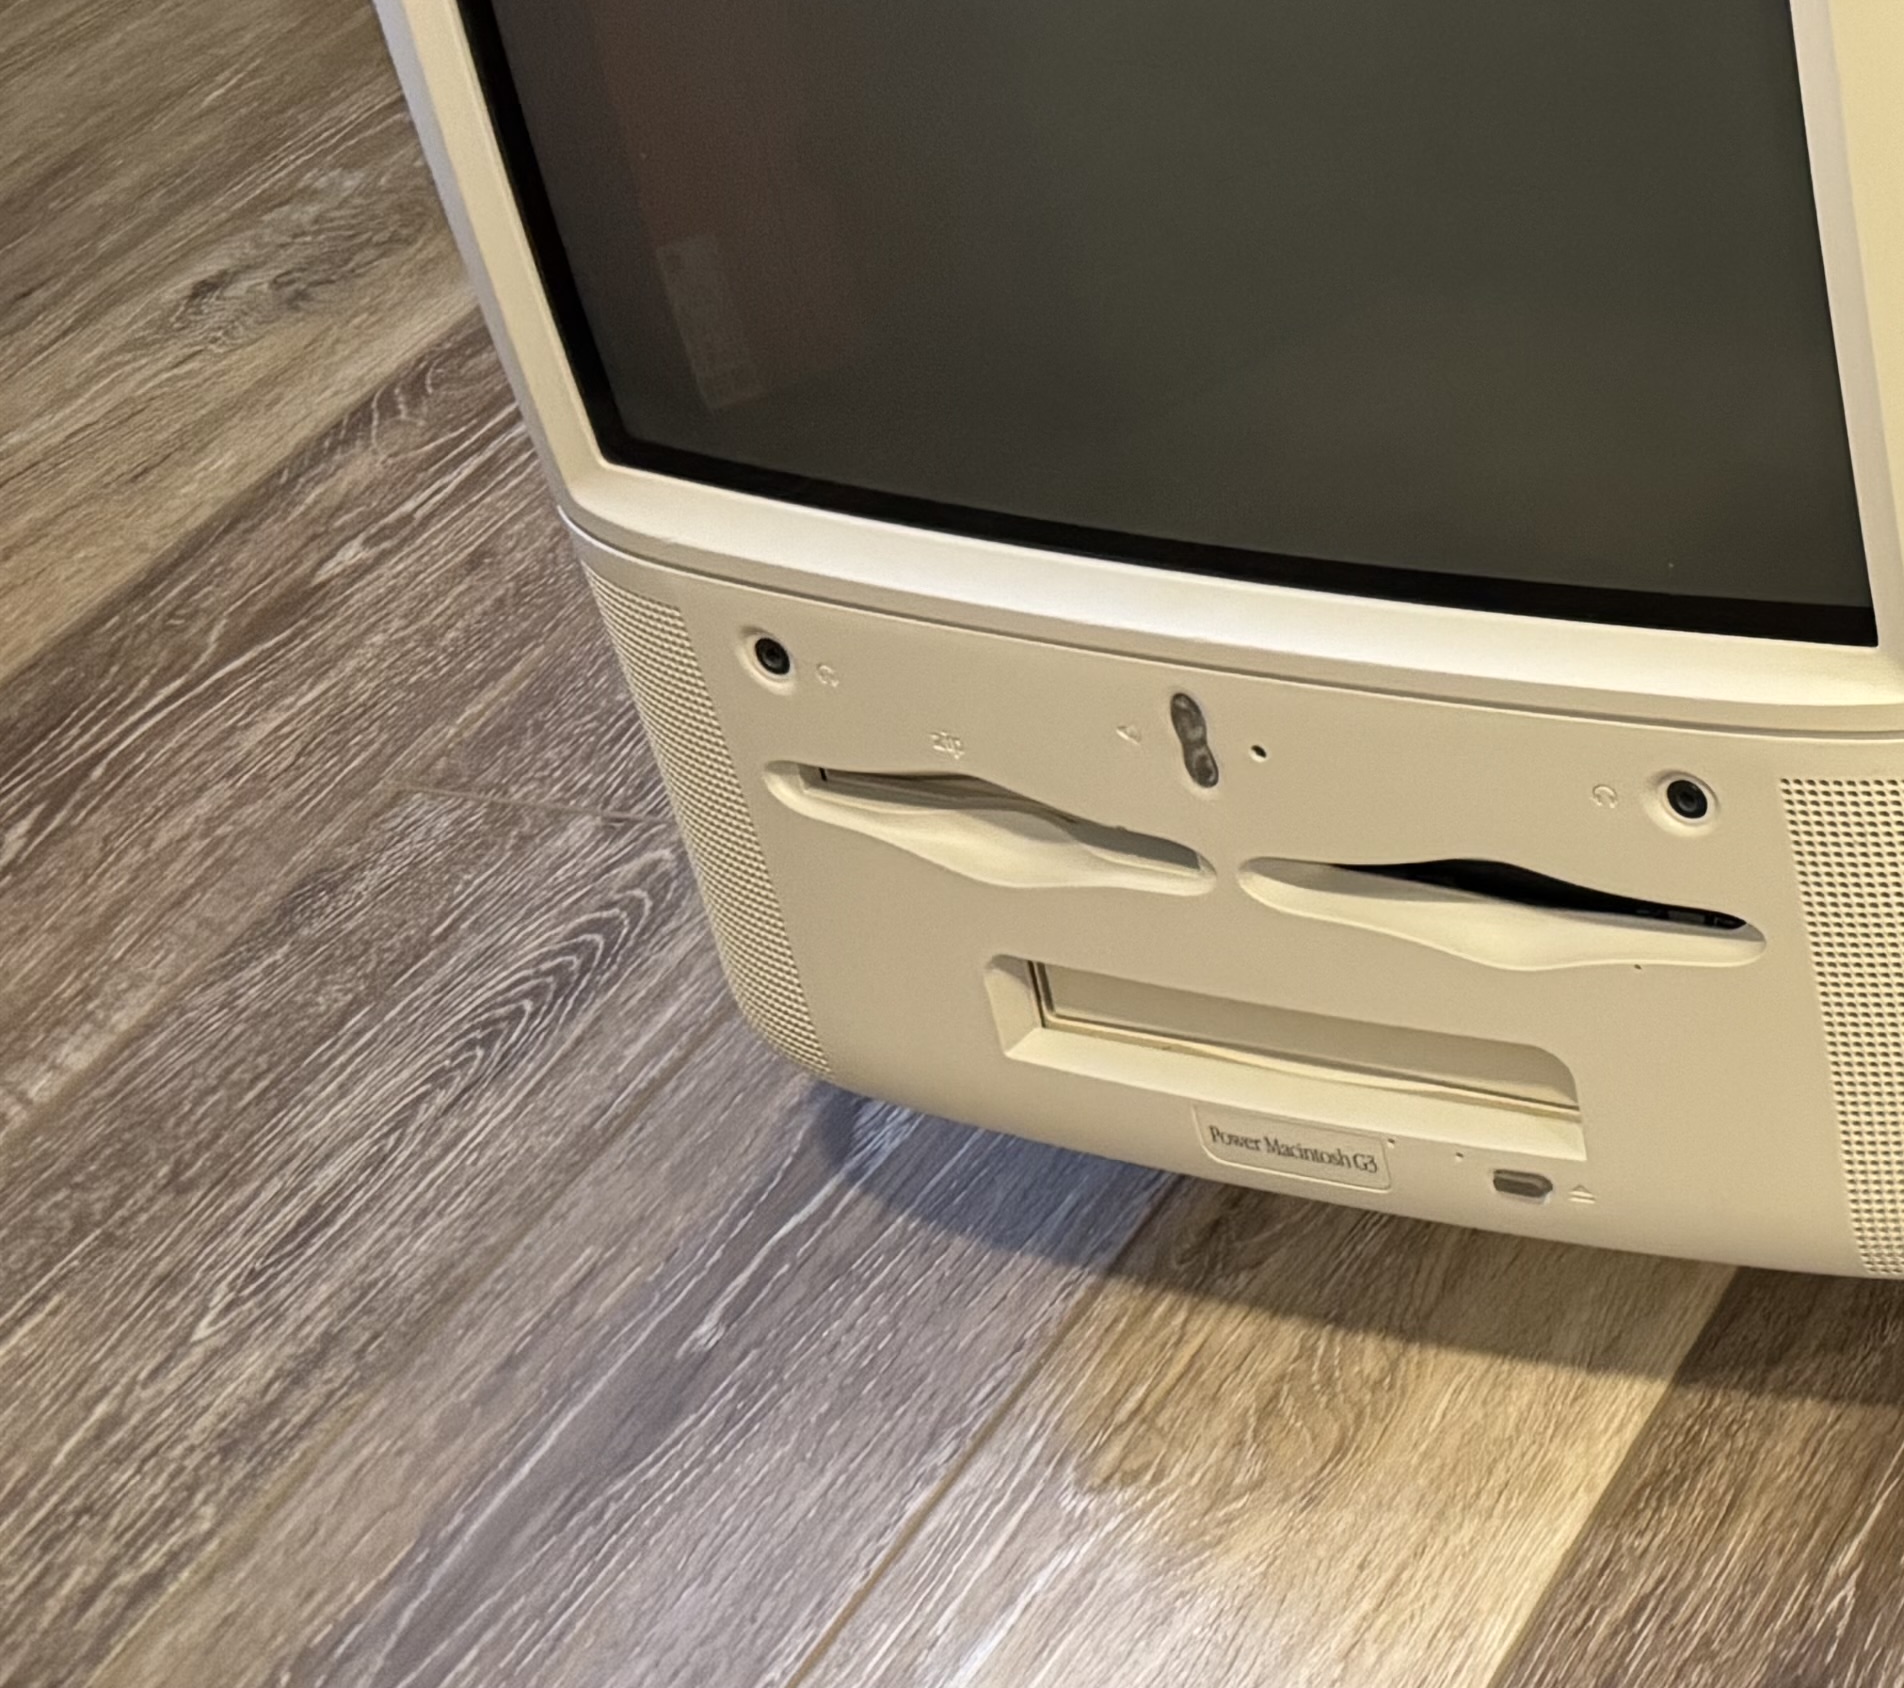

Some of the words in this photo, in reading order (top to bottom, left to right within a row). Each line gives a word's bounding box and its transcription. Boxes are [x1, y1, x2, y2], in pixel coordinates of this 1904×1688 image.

[1208, 1125, 1262, 1152] Power
[1263, 1136, 1351, 1169] Macintosh
[1352, 1153, 1379, 1174] G3
